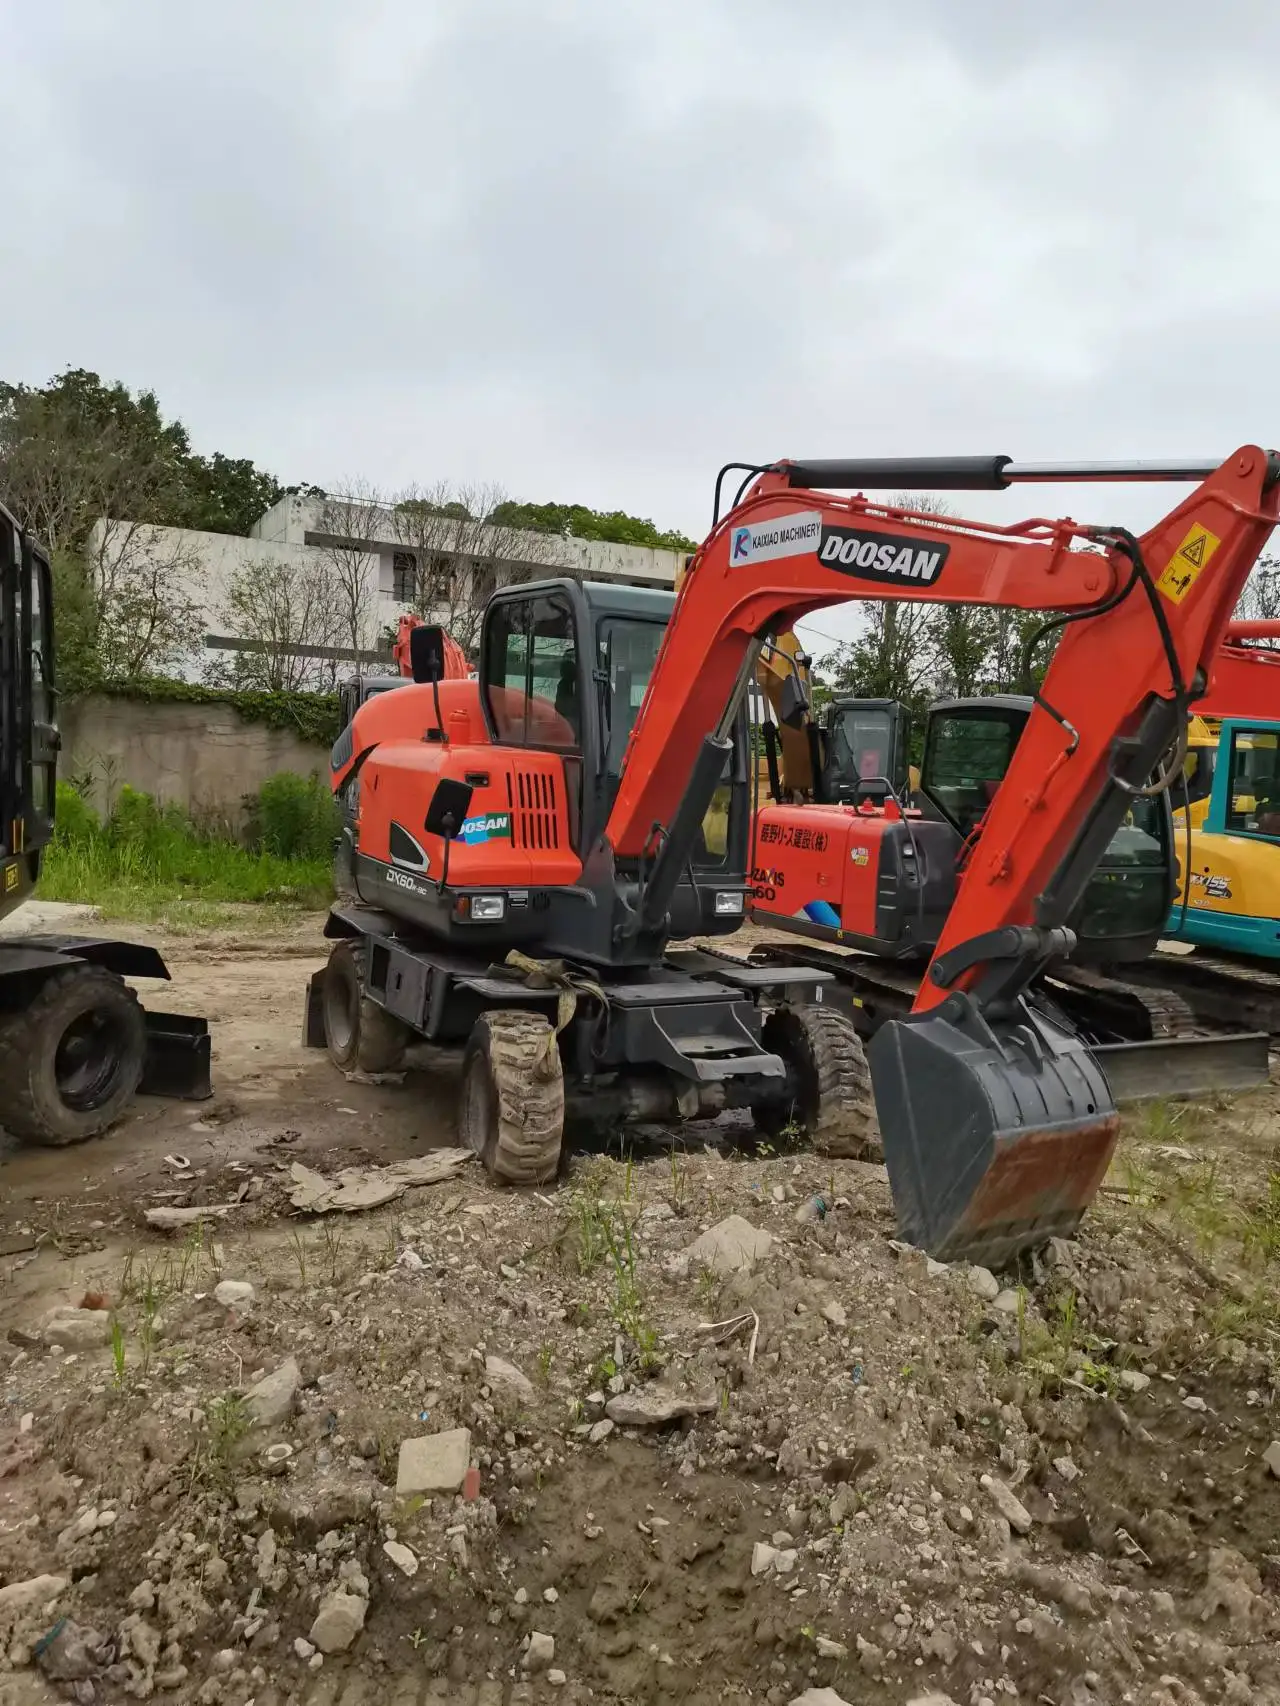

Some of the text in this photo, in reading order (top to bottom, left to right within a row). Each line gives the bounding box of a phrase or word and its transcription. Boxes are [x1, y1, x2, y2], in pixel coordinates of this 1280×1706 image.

[752, 531, 779, 549] KAIXIAO
[779, 522, 820, 543] MACHINERY
[820, 535, 941, 580] DOOSAN
